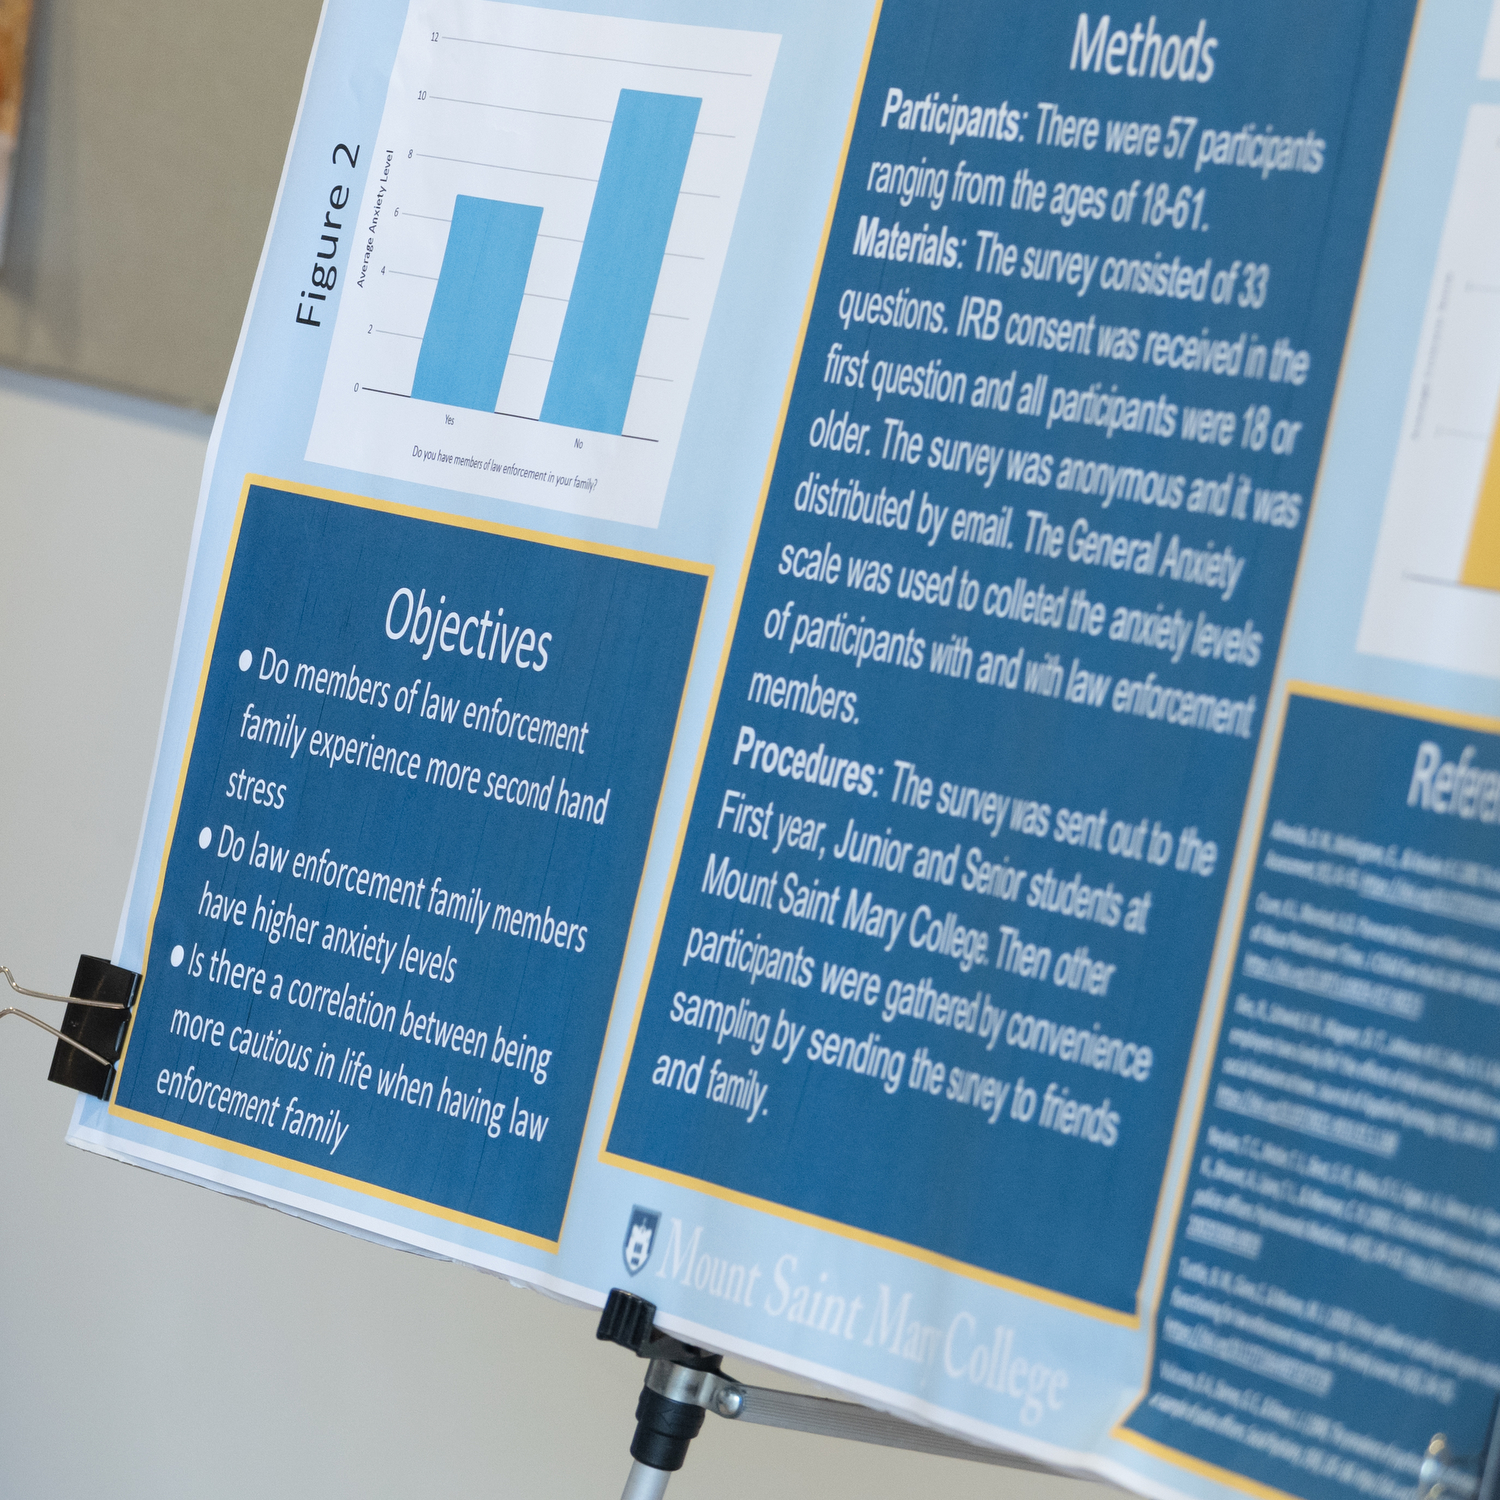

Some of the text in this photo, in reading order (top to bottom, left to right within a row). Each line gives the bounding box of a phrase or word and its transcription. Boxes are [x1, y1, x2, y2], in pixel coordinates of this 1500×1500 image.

[1069, 12, 1218, 83] Methods
[880, 87, 1325, 178] Participants: There were 57 participants
[295, 143, 361, 328] Figure 2
[356, 149, 394, 288] Average Anxiety Level
[866, 156, 1208, 231] ranging from the ages of 18-61.
[852, 214, 1269, 309] Materials: The survey consisted of 33
[444, 414, 455, 426] Yes
[574, 438, 583, 450] No
[412, 445, 598, 494] Do you have members of law enforcement in your family?
[385, 587, 553, 672] Objectives
[258, 646, 589, 755] Do members of law enforcement
[225, 768, 287, 810] stress
[240, 703, 611, 825] family experience more second hand
[732, 721, 884, 800] Procedures:
[217, 824, 588, 953] Do law enforcement family members
[156, 1065, 350, 1156] enforcement family
[652, 1054, 768, 1123] and family.
[655, 1217, 762, 1308] Mount
[764, 1253, 863, 1341] Saint
[944, 1311, 1068, 1427] College
